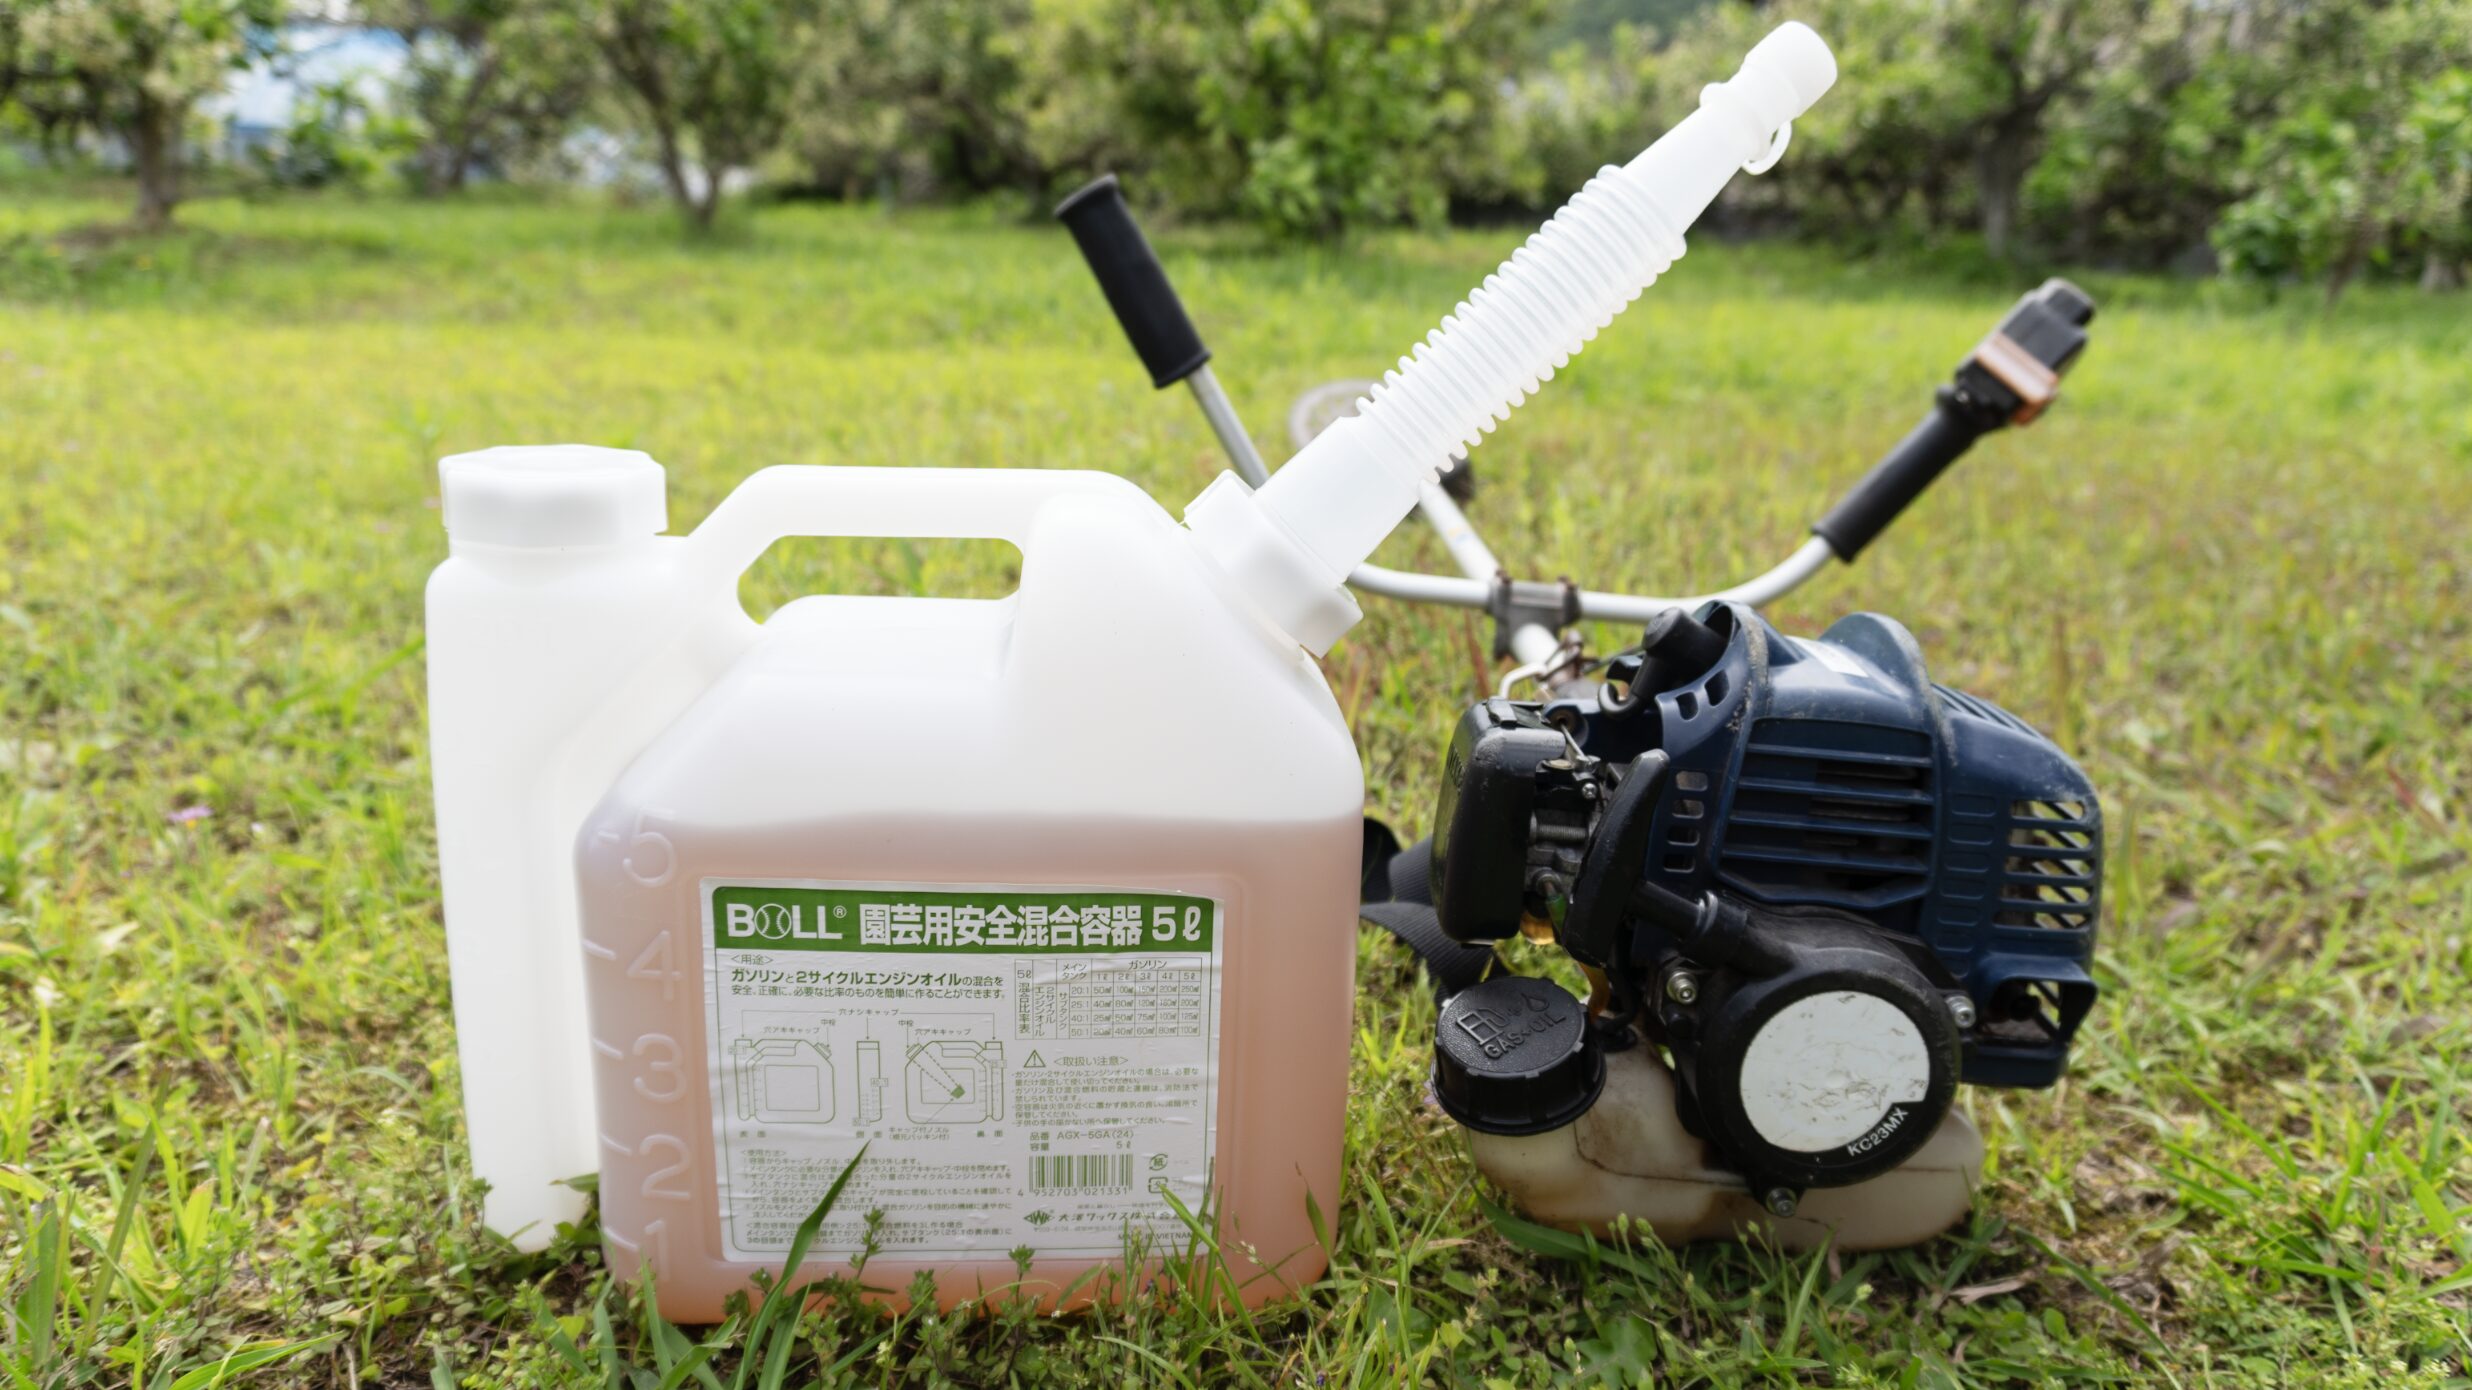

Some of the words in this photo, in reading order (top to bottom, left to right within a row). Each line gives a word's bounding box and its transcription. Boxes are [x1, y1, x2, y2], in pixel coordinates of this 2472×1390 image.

[622, 809, 677, 887] 5
[859, 904, 1142, 946] 園芸用安全混合容器
[627, 930, 684, 1000] 4
[731, 969, 1004, 987] ガソリンと2サイクルエンジンオイルの混合を
[1062, 963, 1087, 972] メイン
[1062, 972, 1088, 980] タンク
[1128, 960, 1168, 970] ガソリン
[632, 1033, 687, 1102] 3
[1847, 1107, 1909, 1156] KC23MX
[640, 1134, 691, 1199] 2
[1018, 1189, 1024, 1197] 4
[1034, 1188, 1078, 1197] 952703
[1084, 1187, 1127, 1196] 021331
[645, 1219, 670, 1281] 1
